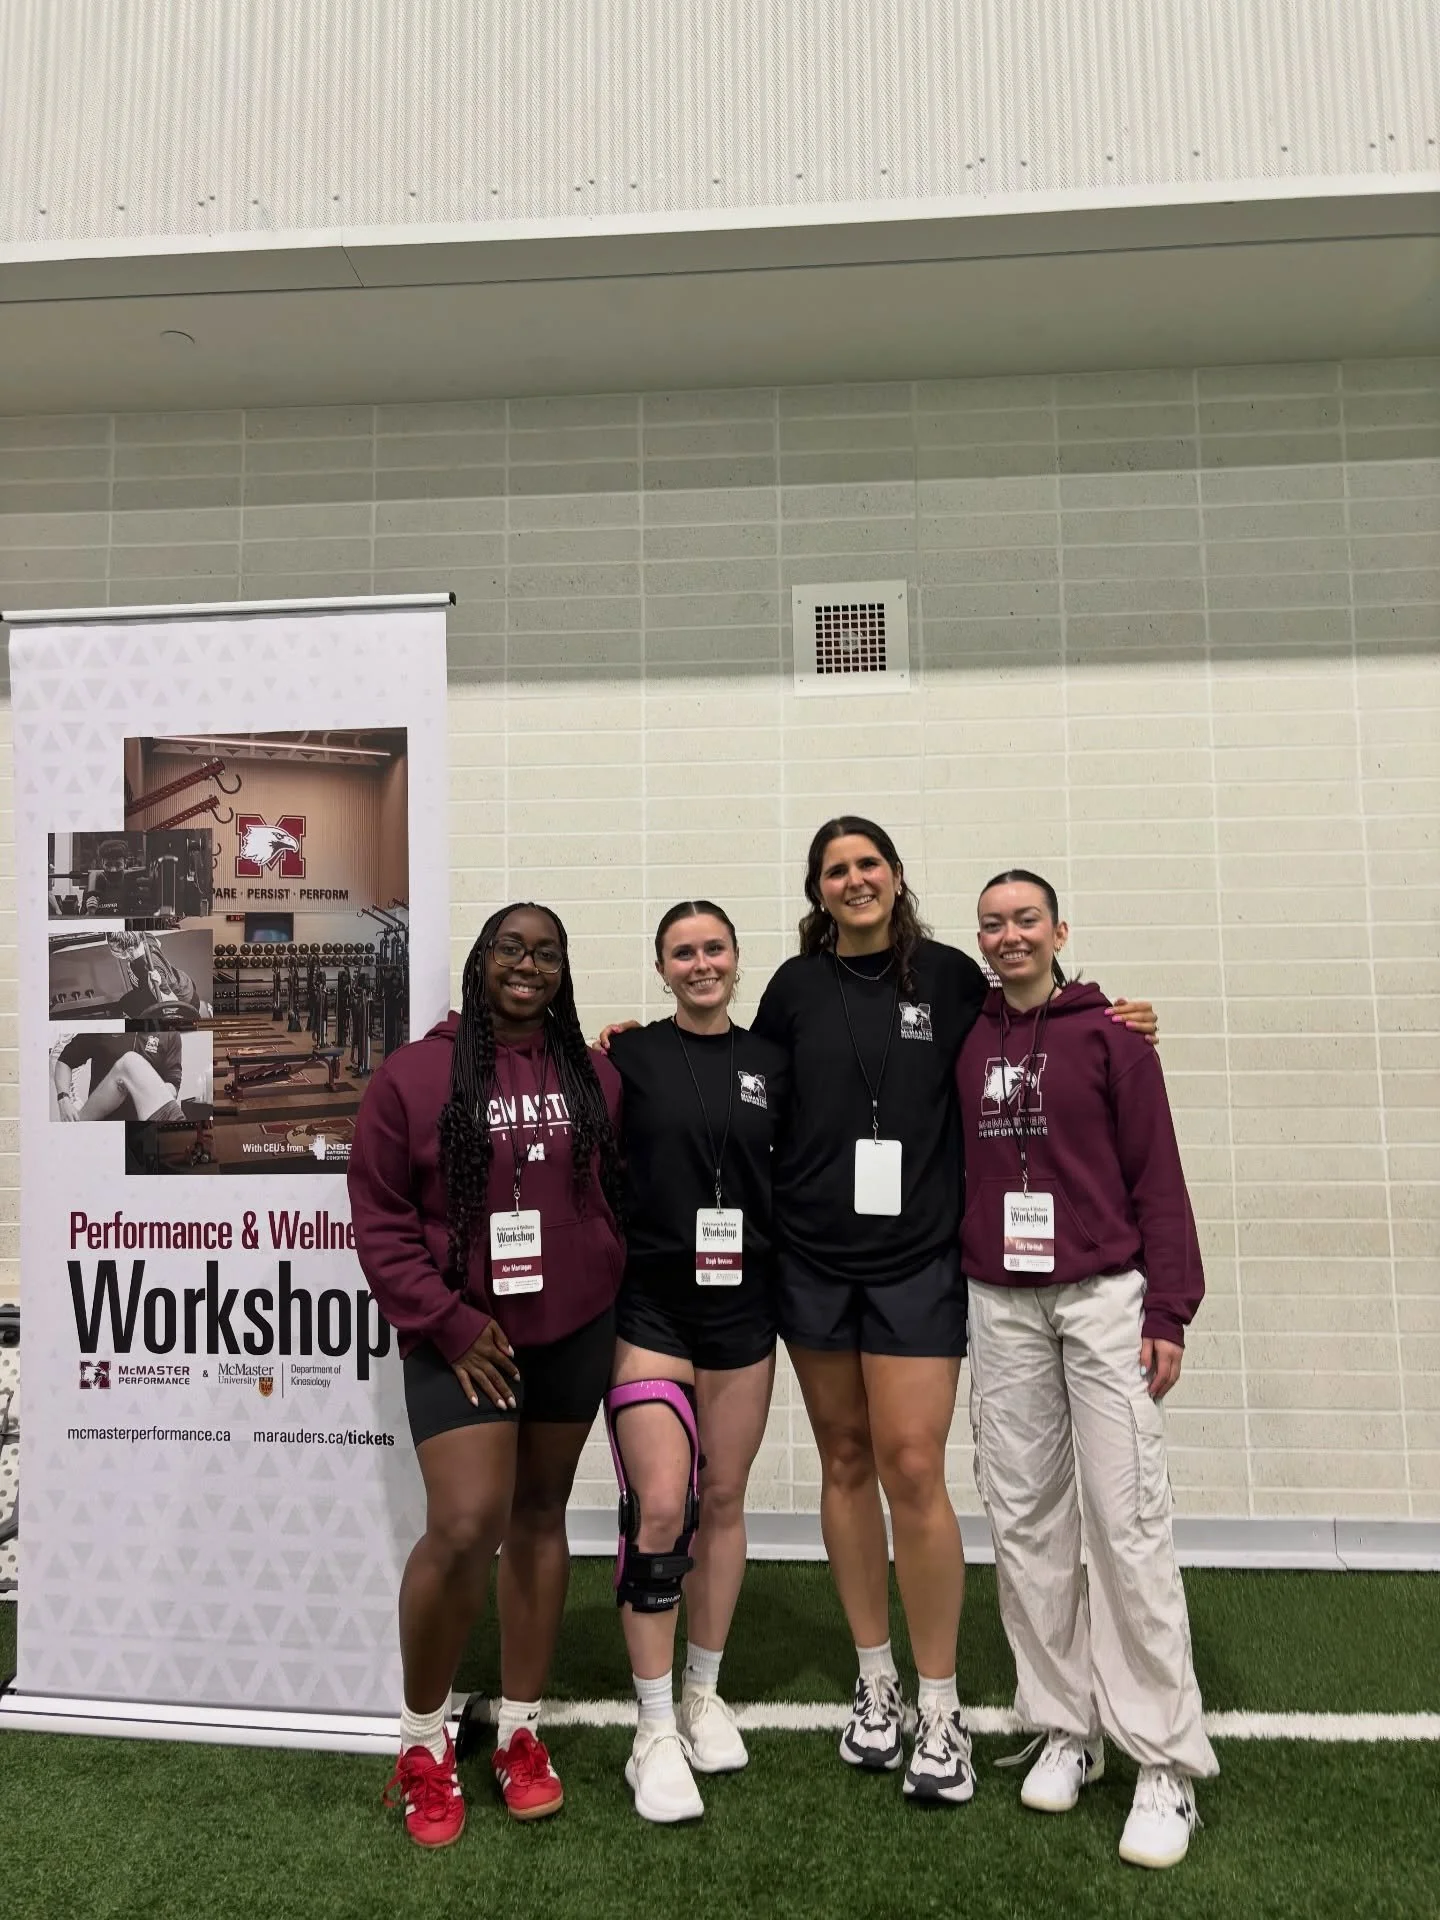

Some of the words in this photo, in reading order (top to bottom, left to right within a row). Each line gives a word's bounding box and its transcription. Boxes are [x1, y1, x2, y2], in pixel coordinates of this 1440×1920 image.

[247, 888, 290, 899] PERSIST
[299, 889, 349, 900] PERFORM
[242, 1143, 262, 1152] With
[263, 1143, 285, 1152] CEU's
[1011, 1210, 1047, 1225] Workshop
[70, 1211, 232, 1250] Performance
[242, 1210, 259, 1250] &
[268, 1210, 357, 1250] Wellne
[703, 1227, 737, 1240] Workshop
[497, 1231, 534, 1243] Workshop
[67, 1259, 391, 1381] Workshop
[118, 1365, 190, 1376] McMASTER
[202, 1369, 209, 1378] &
[218, 1363, 274, 1377] McMaster
[291, 1364, 331, 1376] Department
[333, 1365, 341, 1374] of
[118, 1377, 190, 1385] PERFORMANCE
[218, 1376, 257, 1387] University
[291, 1376, 331, 1388] Kinesiology
[67, 1426, 231, 1443] mcmasterperformance.ca
[253, 1429, 395, 1446] marauders.ca/tickets
